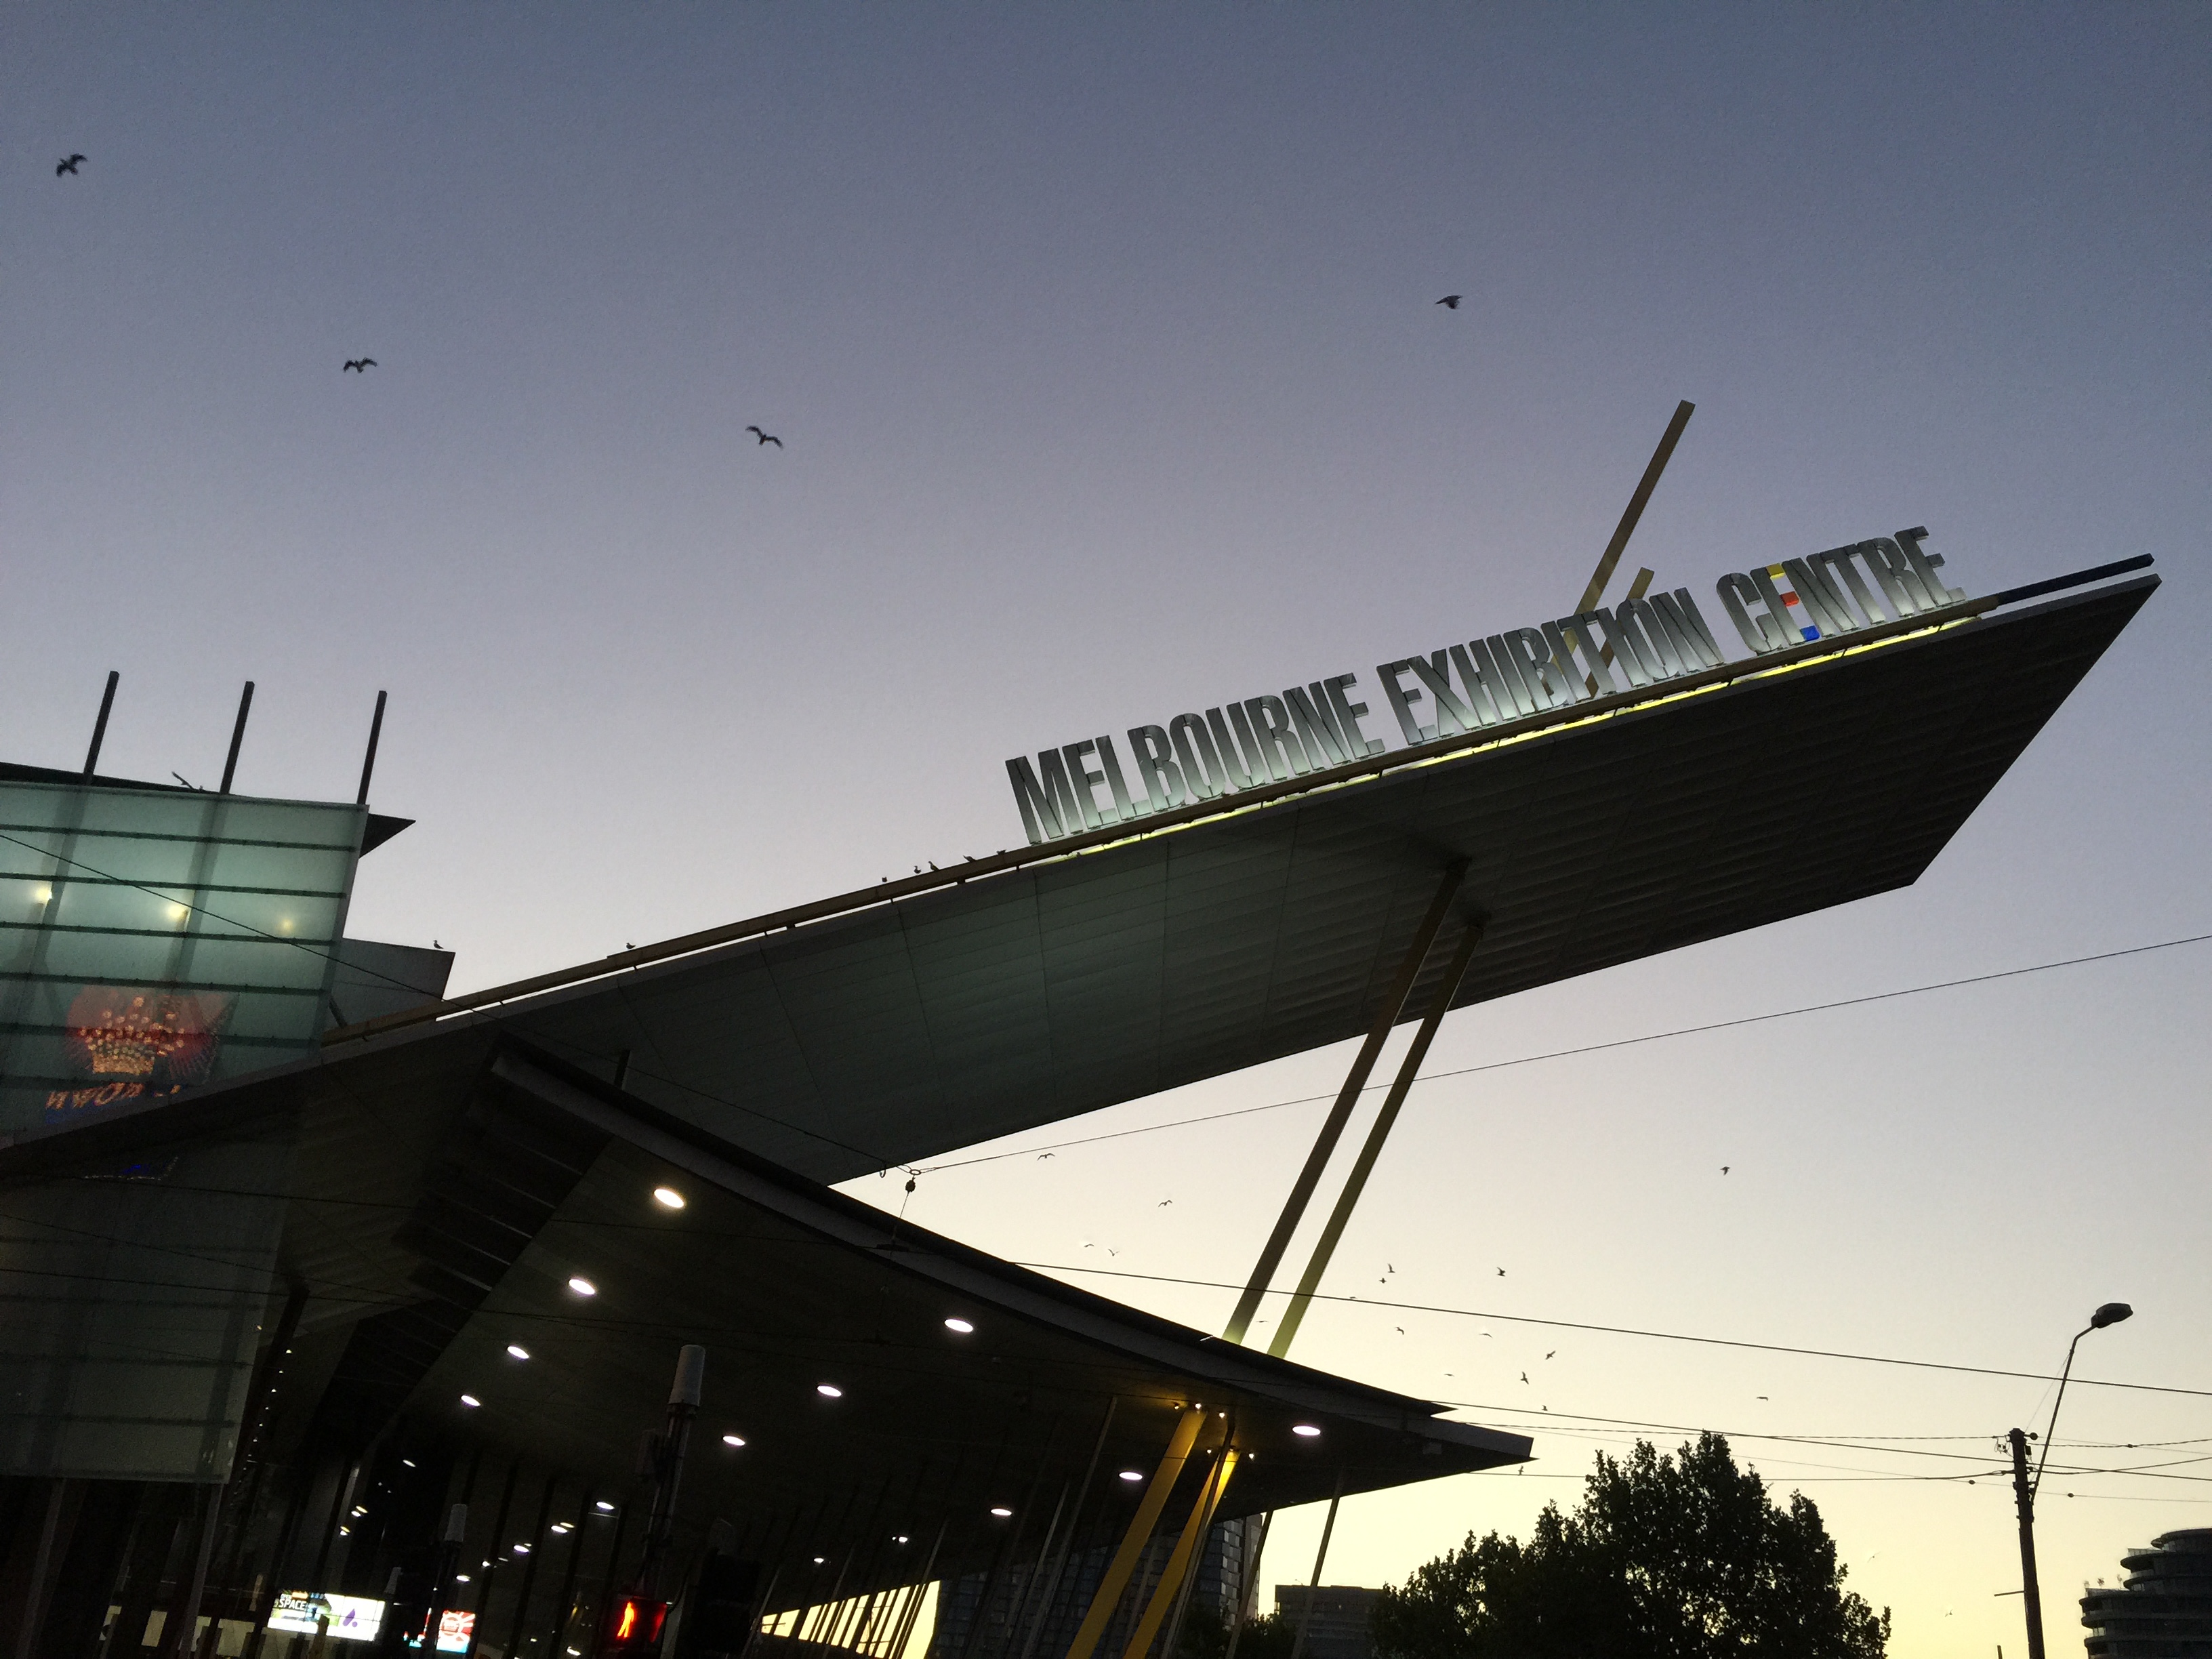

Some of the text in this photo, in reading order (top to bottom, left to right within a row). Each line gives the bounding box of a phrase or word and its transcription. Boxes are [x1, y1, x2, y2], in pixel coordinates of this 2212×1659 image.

[1005, 525, 1966, 844] MELBOURNE EXHIBITION CENTRE
[278, 1598, 306, 1610] SPACE
